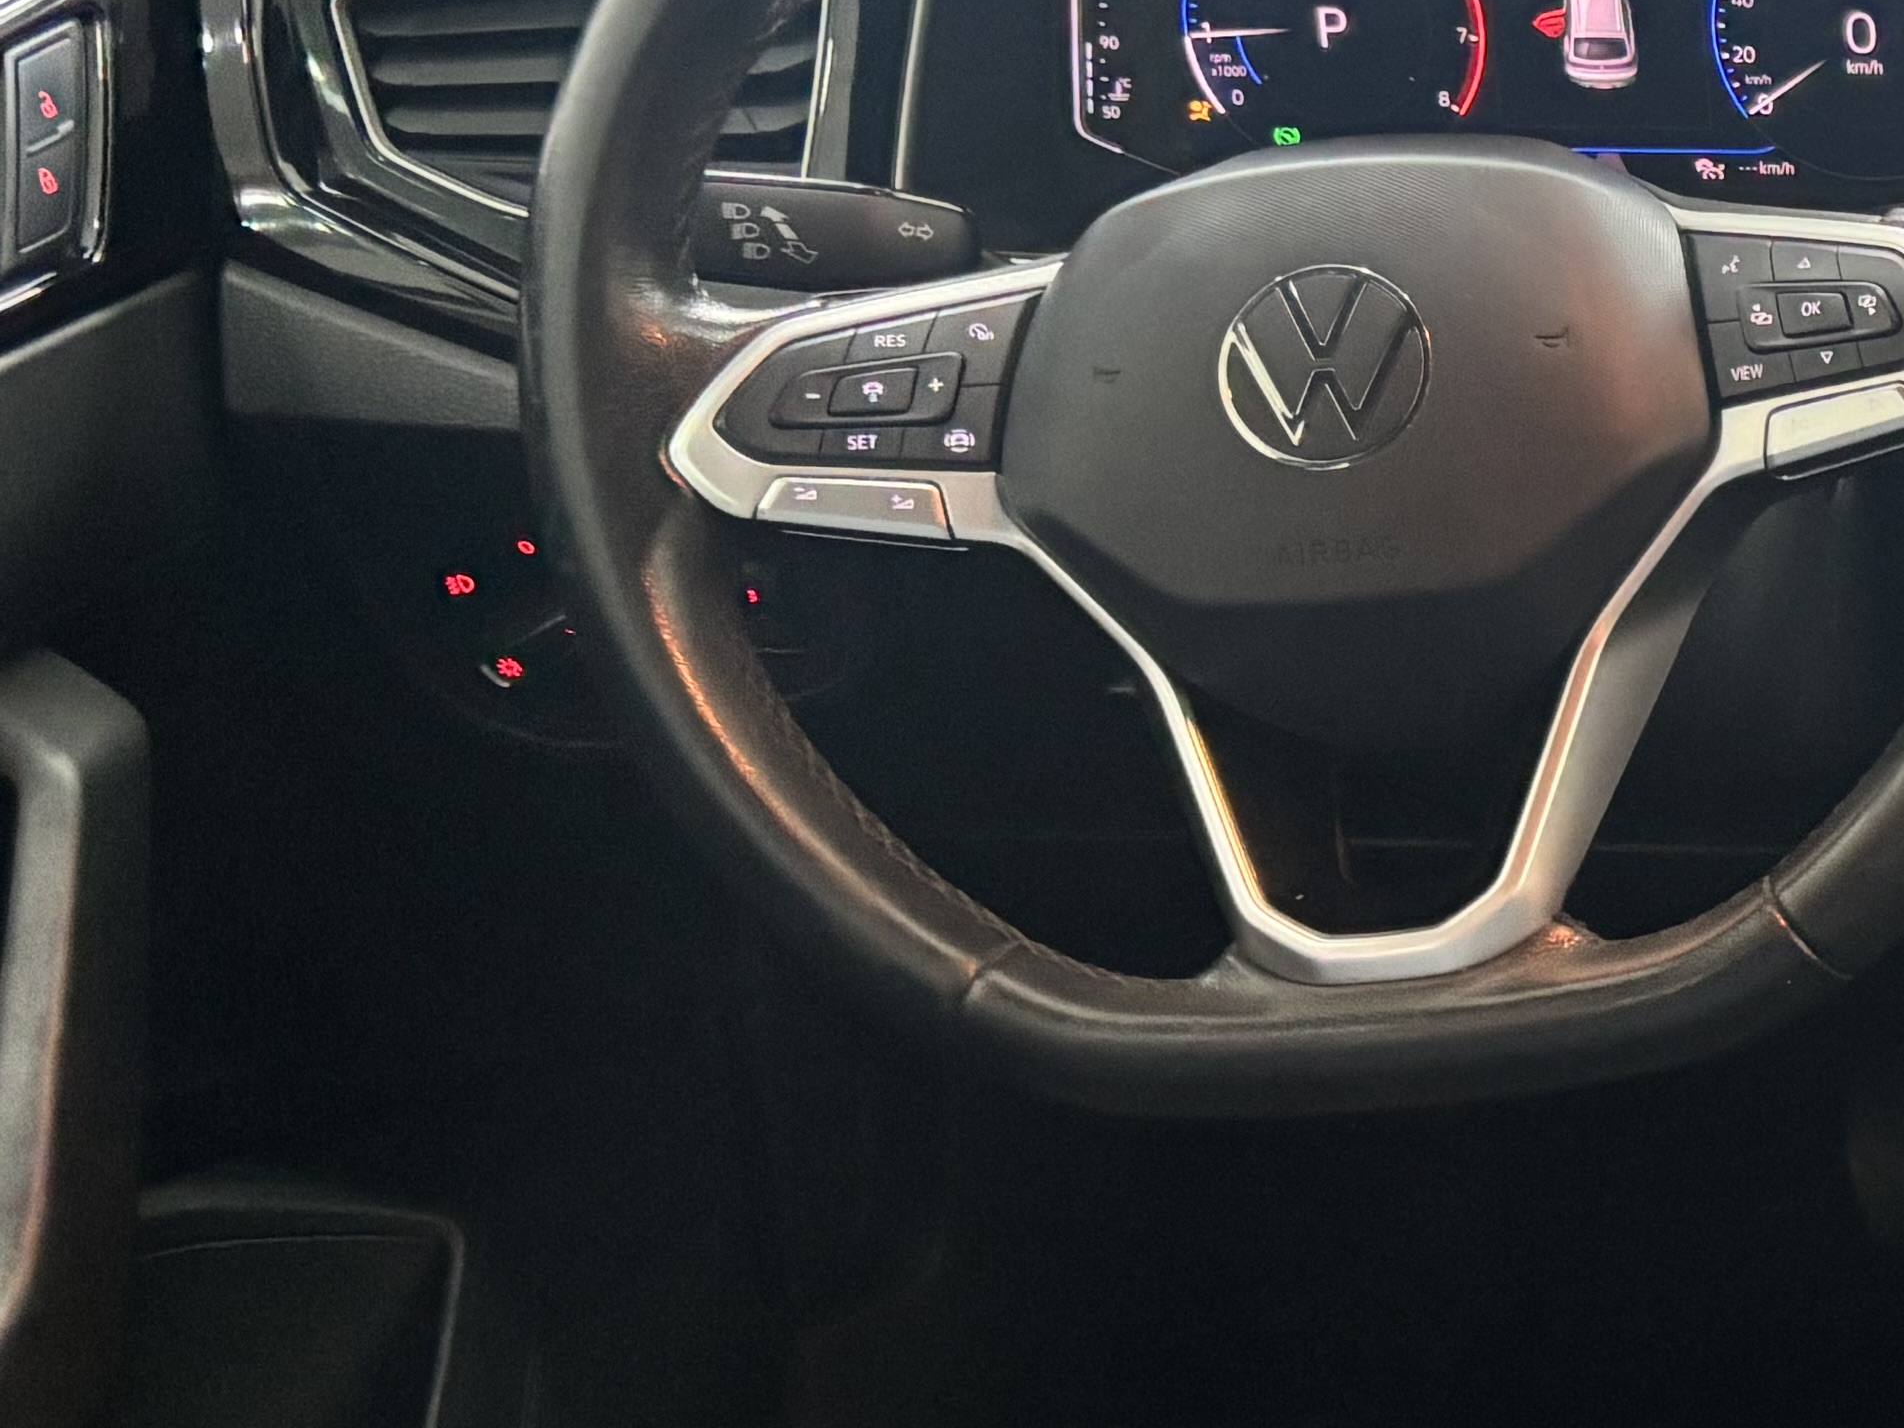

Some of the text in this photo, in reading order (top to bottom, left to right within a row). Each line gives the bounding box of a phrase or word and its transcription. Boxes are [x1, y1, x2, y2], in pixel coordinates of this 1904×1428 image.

[1315, 5, 1348, 49] P
[1456, 27, 1468, 43] 7
[1844, 11, 1877, 55] 0
[1100, 36, 1119, 50] 90
[1732, 47, 1756, 64] 20
[1846, 59, 1884, 77] km/h
[1231, 89, 1244, 105] 0
[1438, 91, 1450, 107] 8
[1102, 106, 1121, 119] 50
[1801, 301, 1821, 317] OK
[874, 333, 906, 349] RES
[1730, 364, 1763, 382] VIEW
[847, 435, 878, 450] SET
